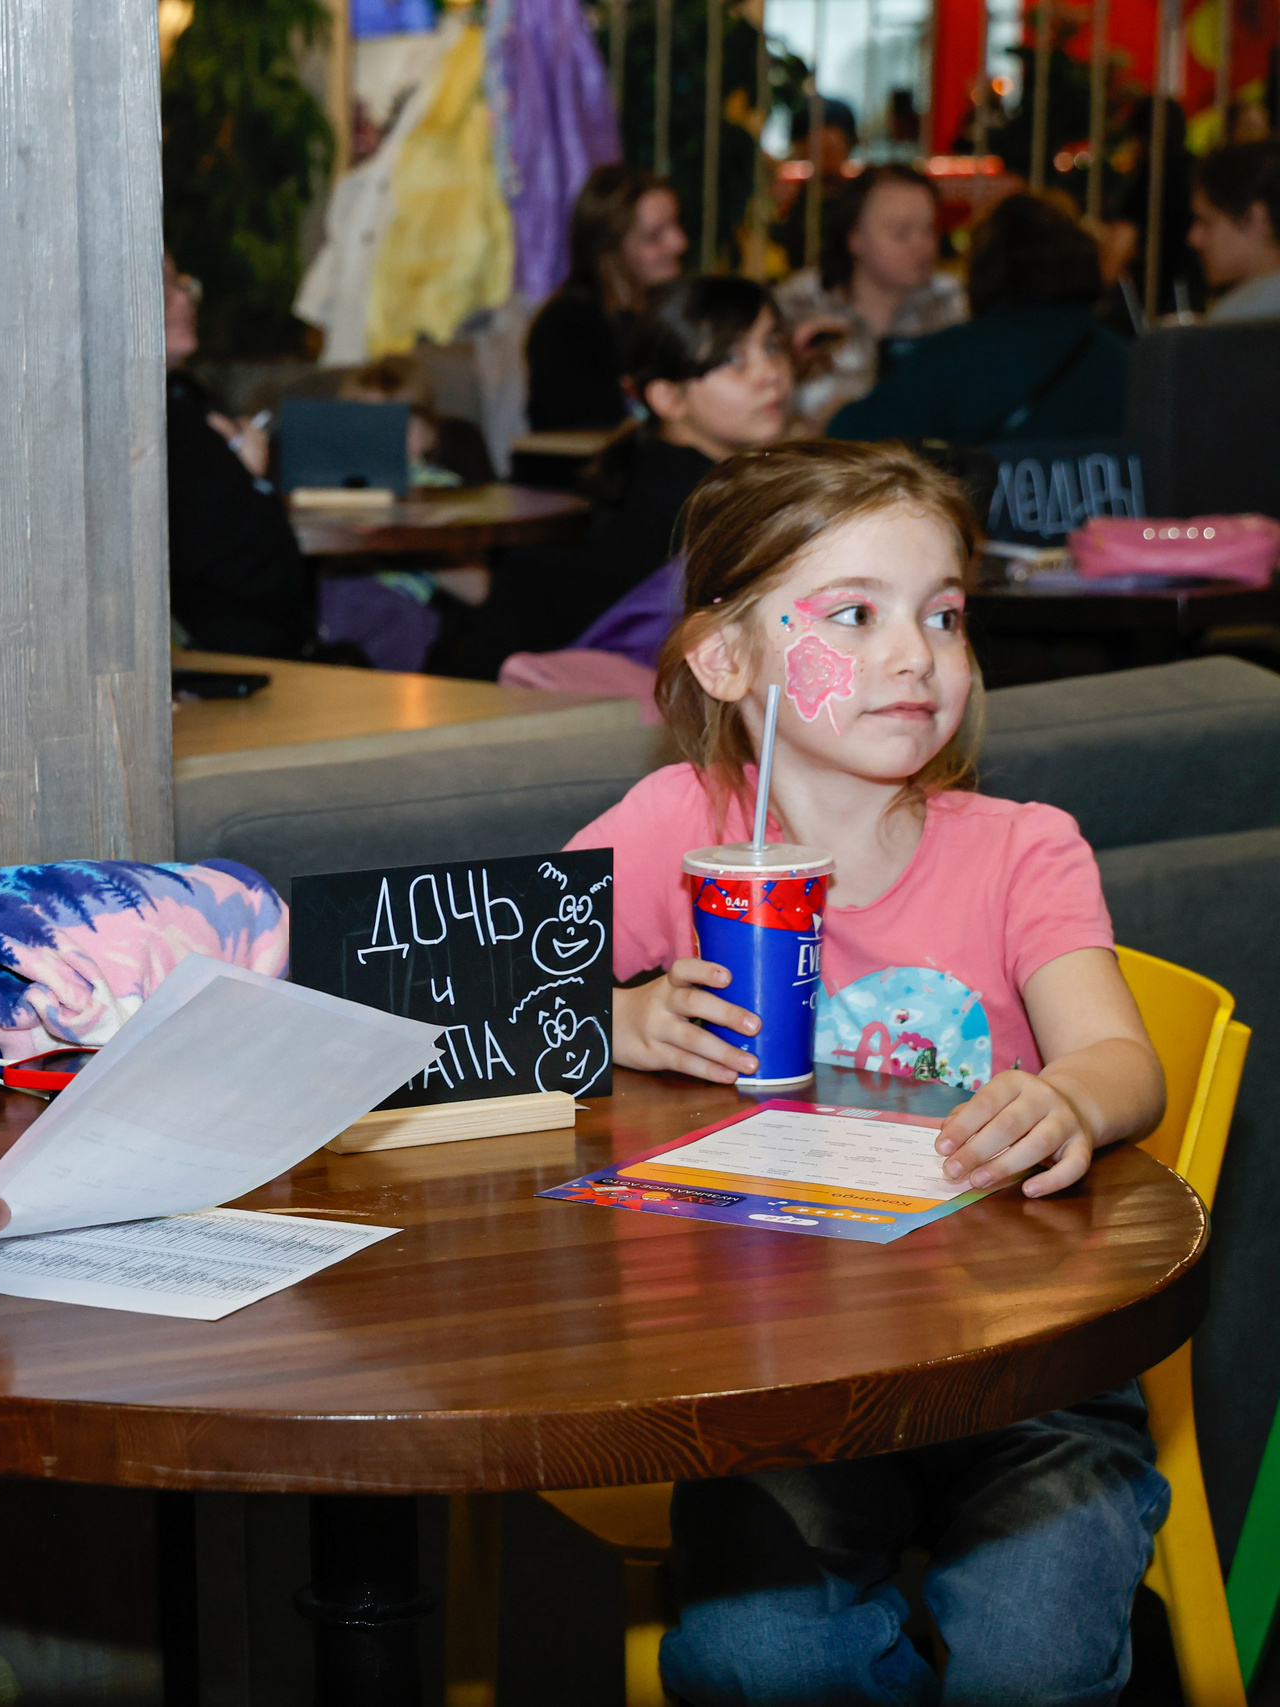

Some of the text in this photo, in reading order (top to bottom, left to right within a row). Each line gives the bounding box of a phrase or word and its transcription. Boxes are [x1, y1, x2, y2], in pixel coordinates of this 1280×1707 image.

[357, 868, 524, 964] ДОЧЬ
[407, 1021, 516, 1091] АПА
[831, 1193, 912, 1207] Команда
